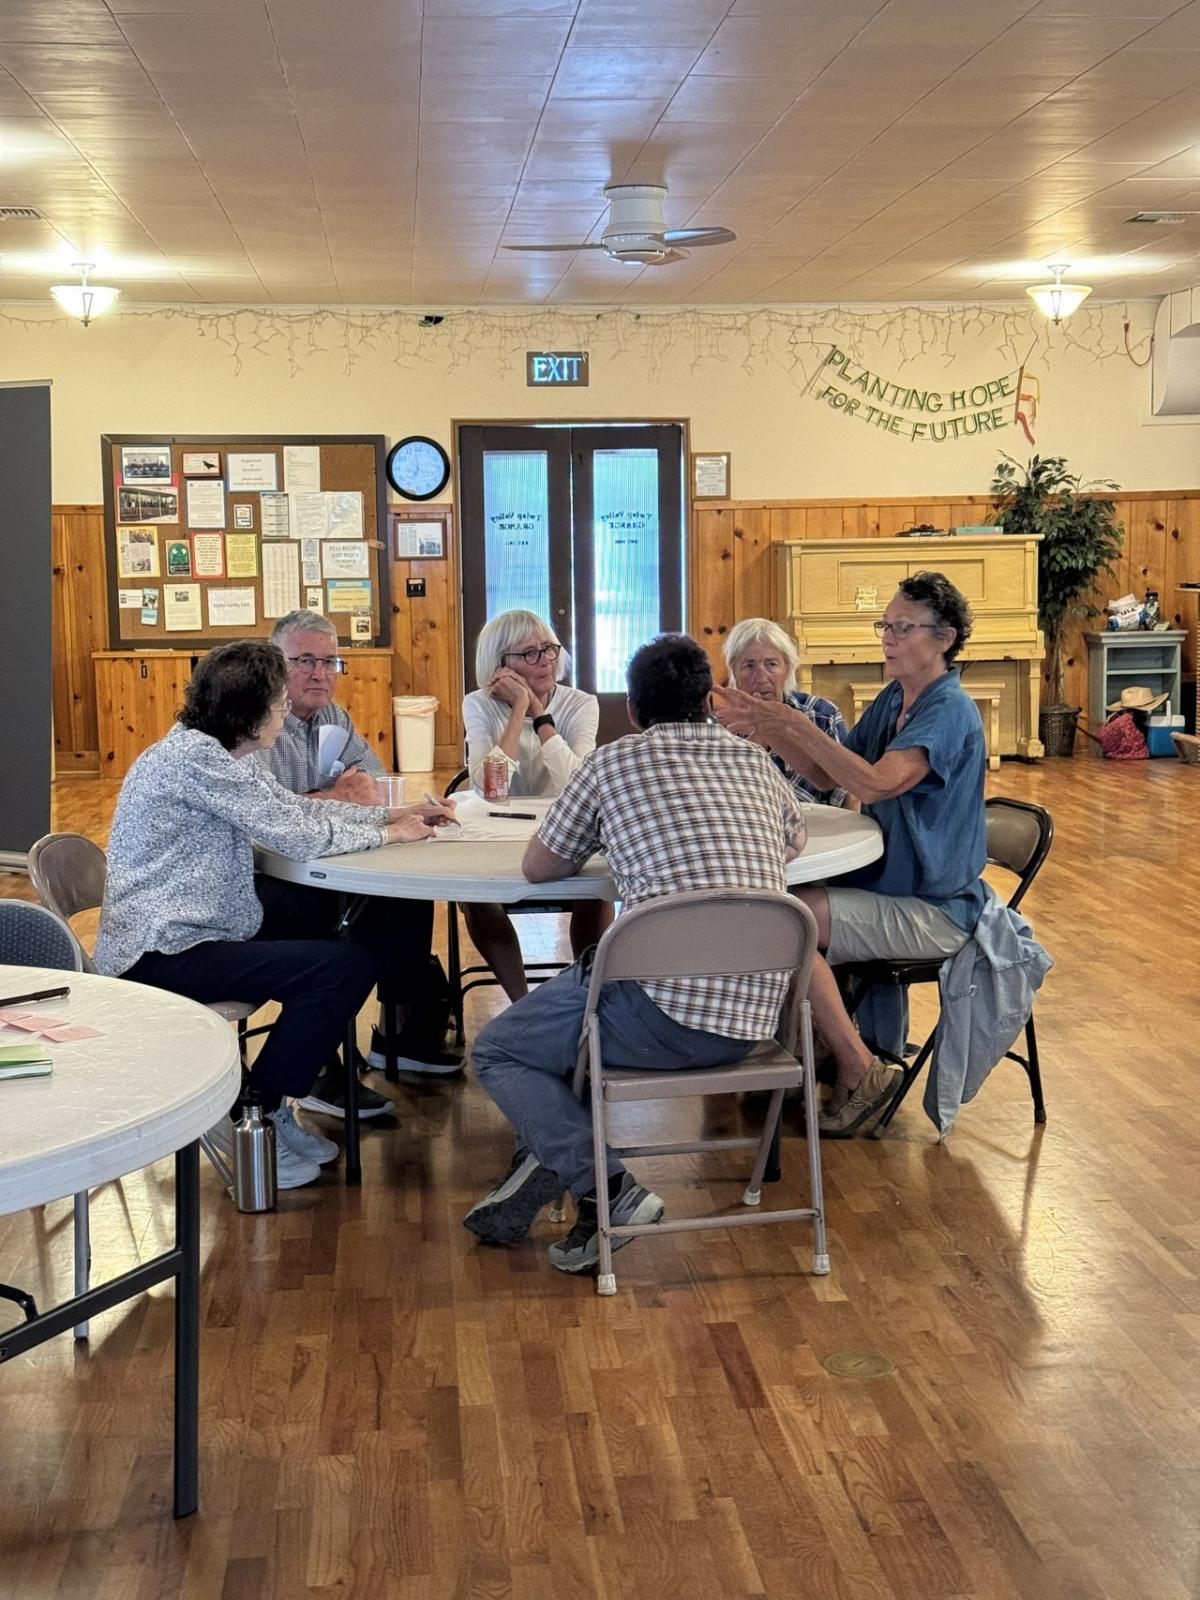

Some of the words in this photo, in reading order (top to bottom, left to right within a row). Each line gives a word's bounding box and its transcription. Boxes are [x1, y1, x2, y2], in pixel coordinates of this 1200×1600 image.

[533, 357, 582, 381] EXIT
[828, 349, 943, 413] PLANTING
[950, 376, 1016, 411] HOPE
[821, 385, 861, 417] FOR
[865, 405, 904, 436] THE
[911, 407, 1008, 443] FUTURE
